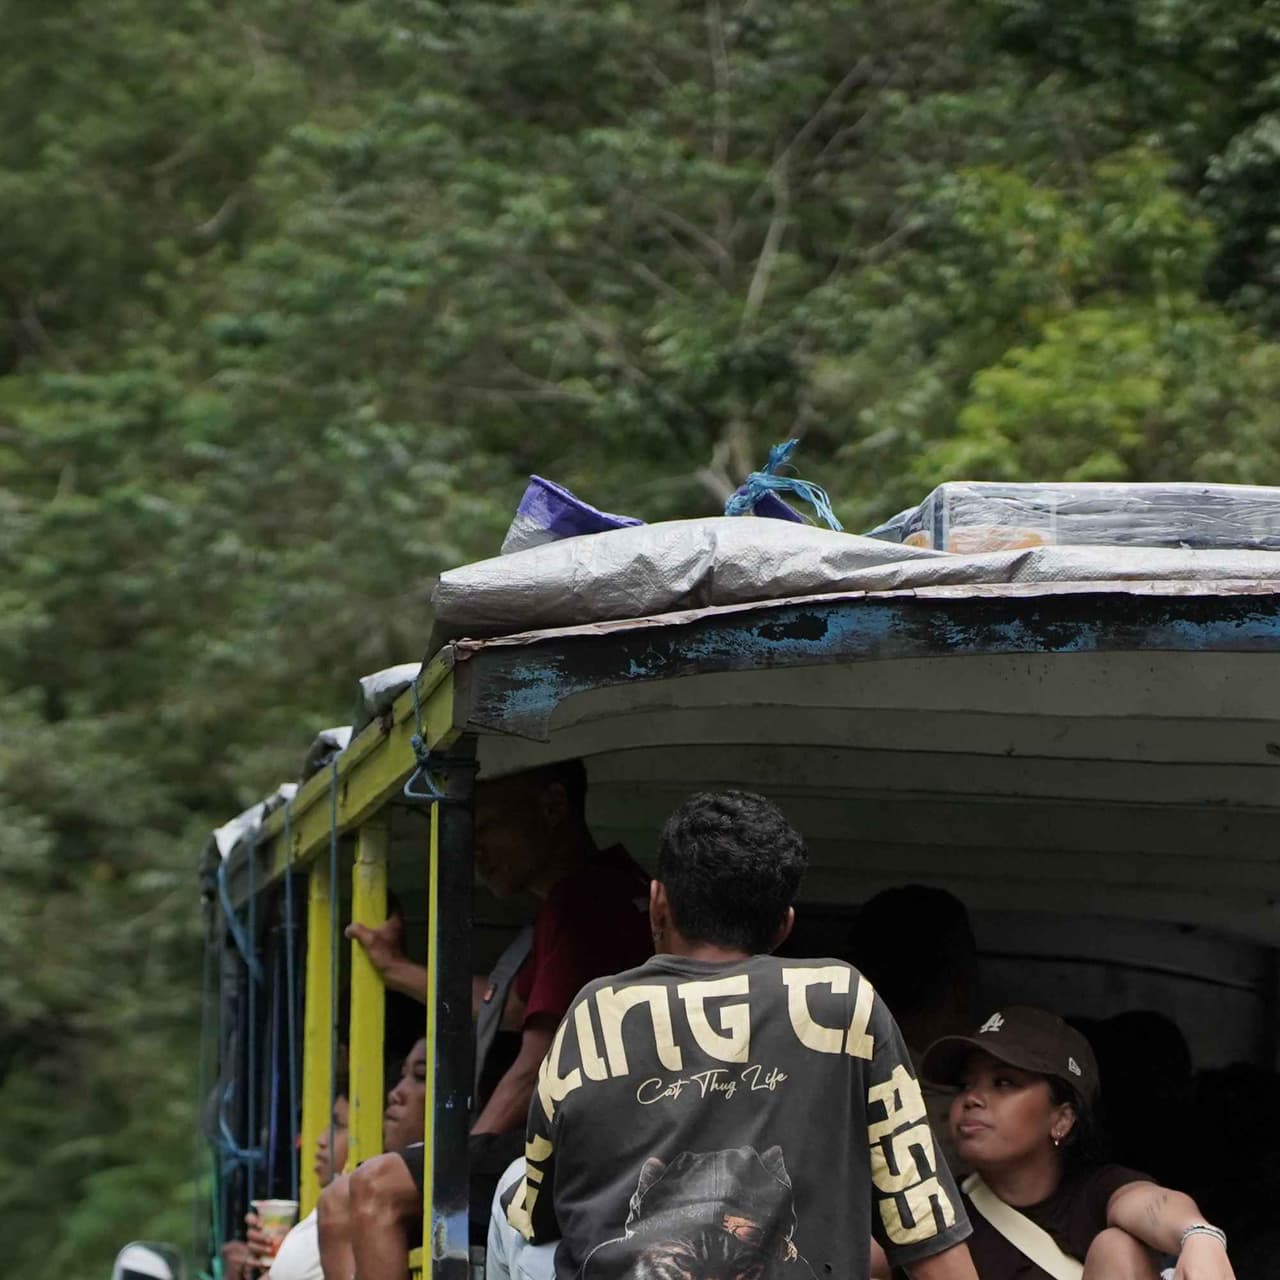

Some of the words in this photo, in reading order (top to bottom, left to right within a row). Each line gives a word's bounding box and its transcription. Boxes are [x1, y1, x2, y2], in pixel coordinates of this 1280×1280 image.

[636, 1077, 690, 1105] Cat
[689, 1068, 739, 1100] Thug
[740, 1064, 789, 1092] Life
